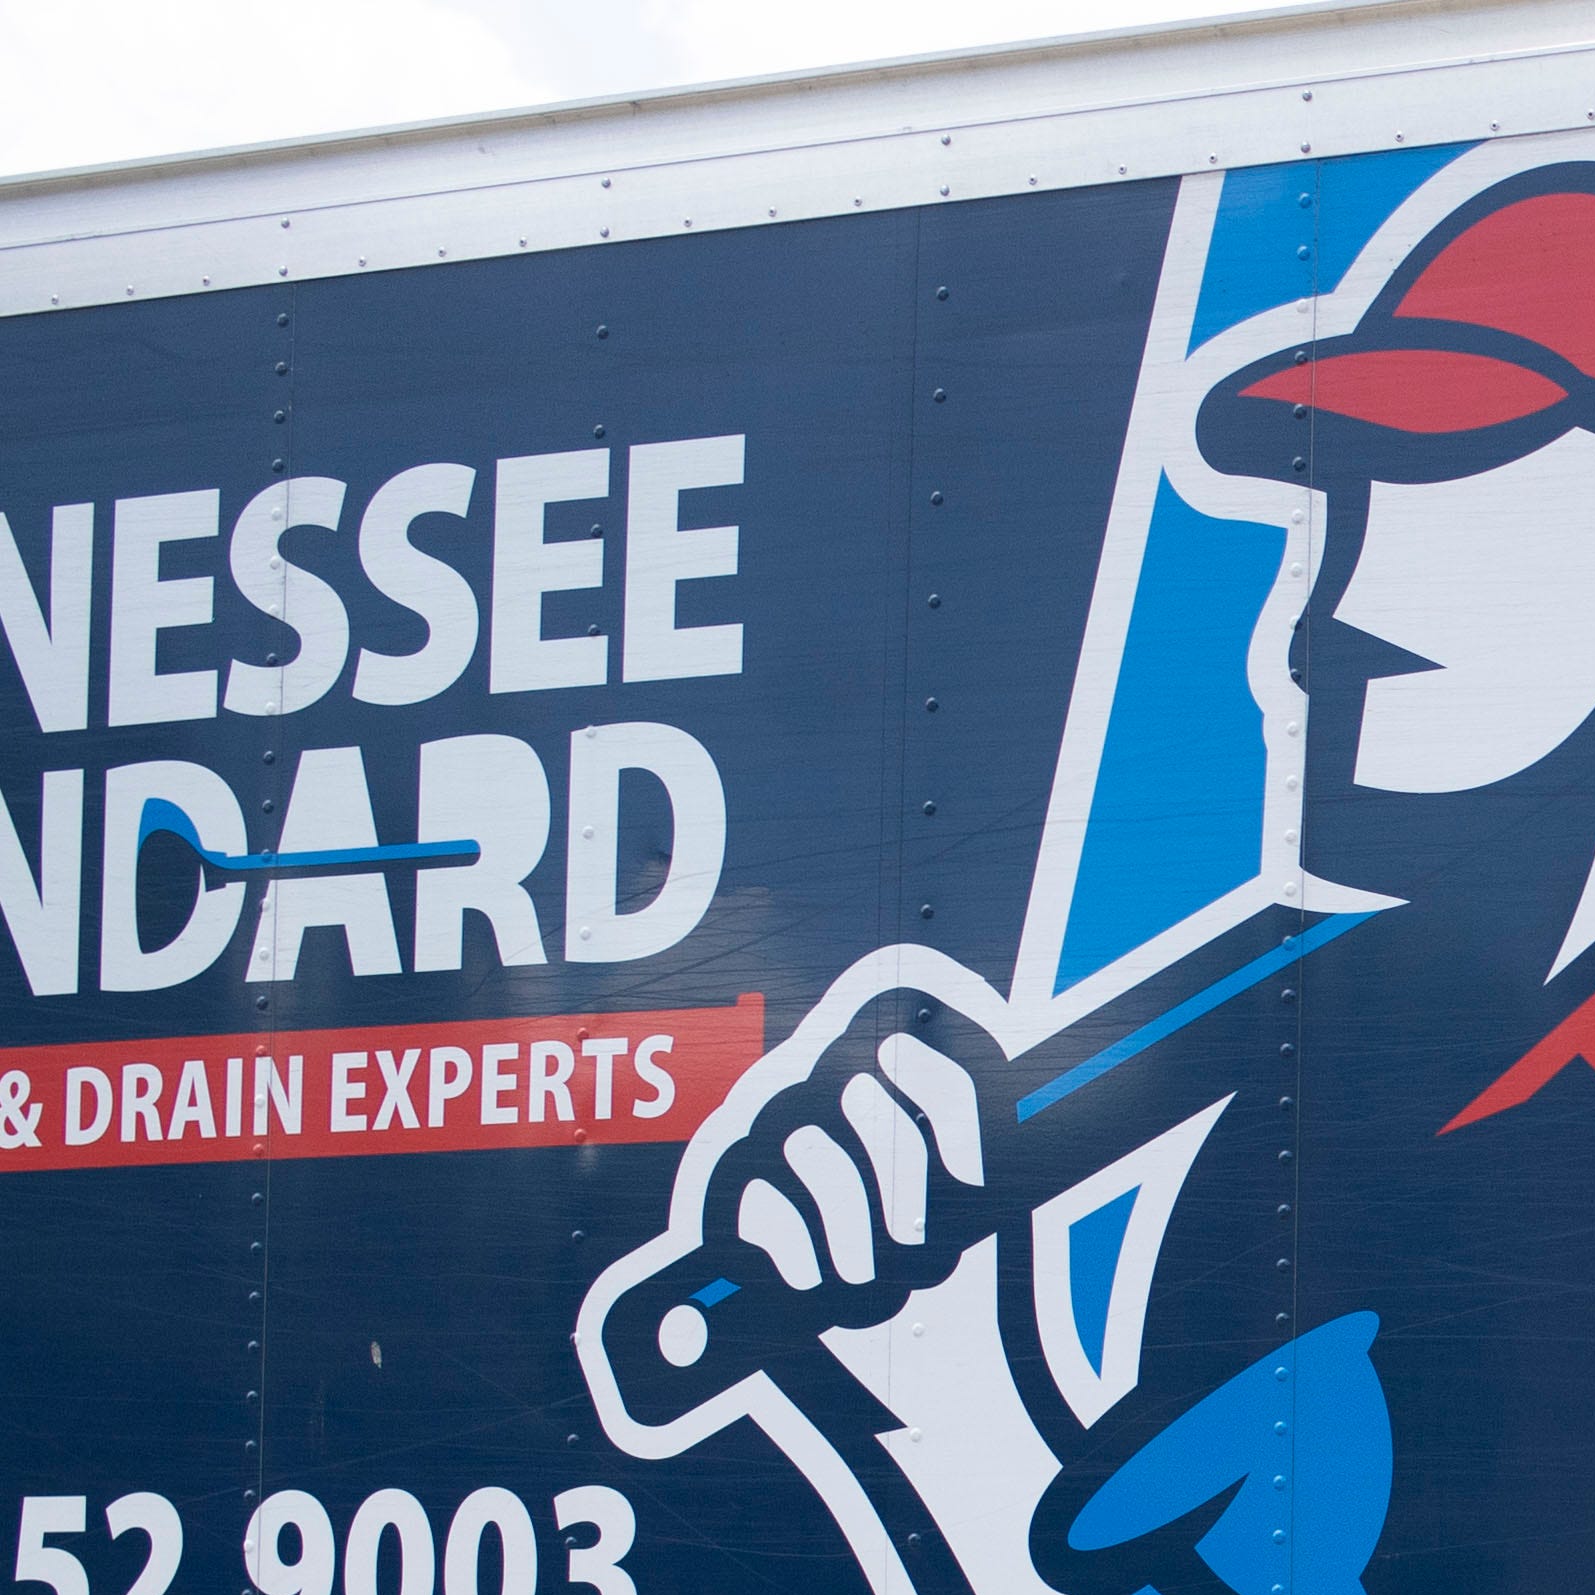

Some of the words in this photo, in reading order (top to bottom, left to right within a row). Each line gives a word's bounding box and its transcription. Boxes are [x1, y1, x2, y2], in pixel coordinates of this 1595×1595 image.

[0, 433, 746, 733] NESSEE
[0, 721, 727, 996] NDARD
[0, 1069, 44, 1149] &
[65, 1055, 304, 1146] DRAIN
[330, 1034, 676, 1133] EXPERTS
